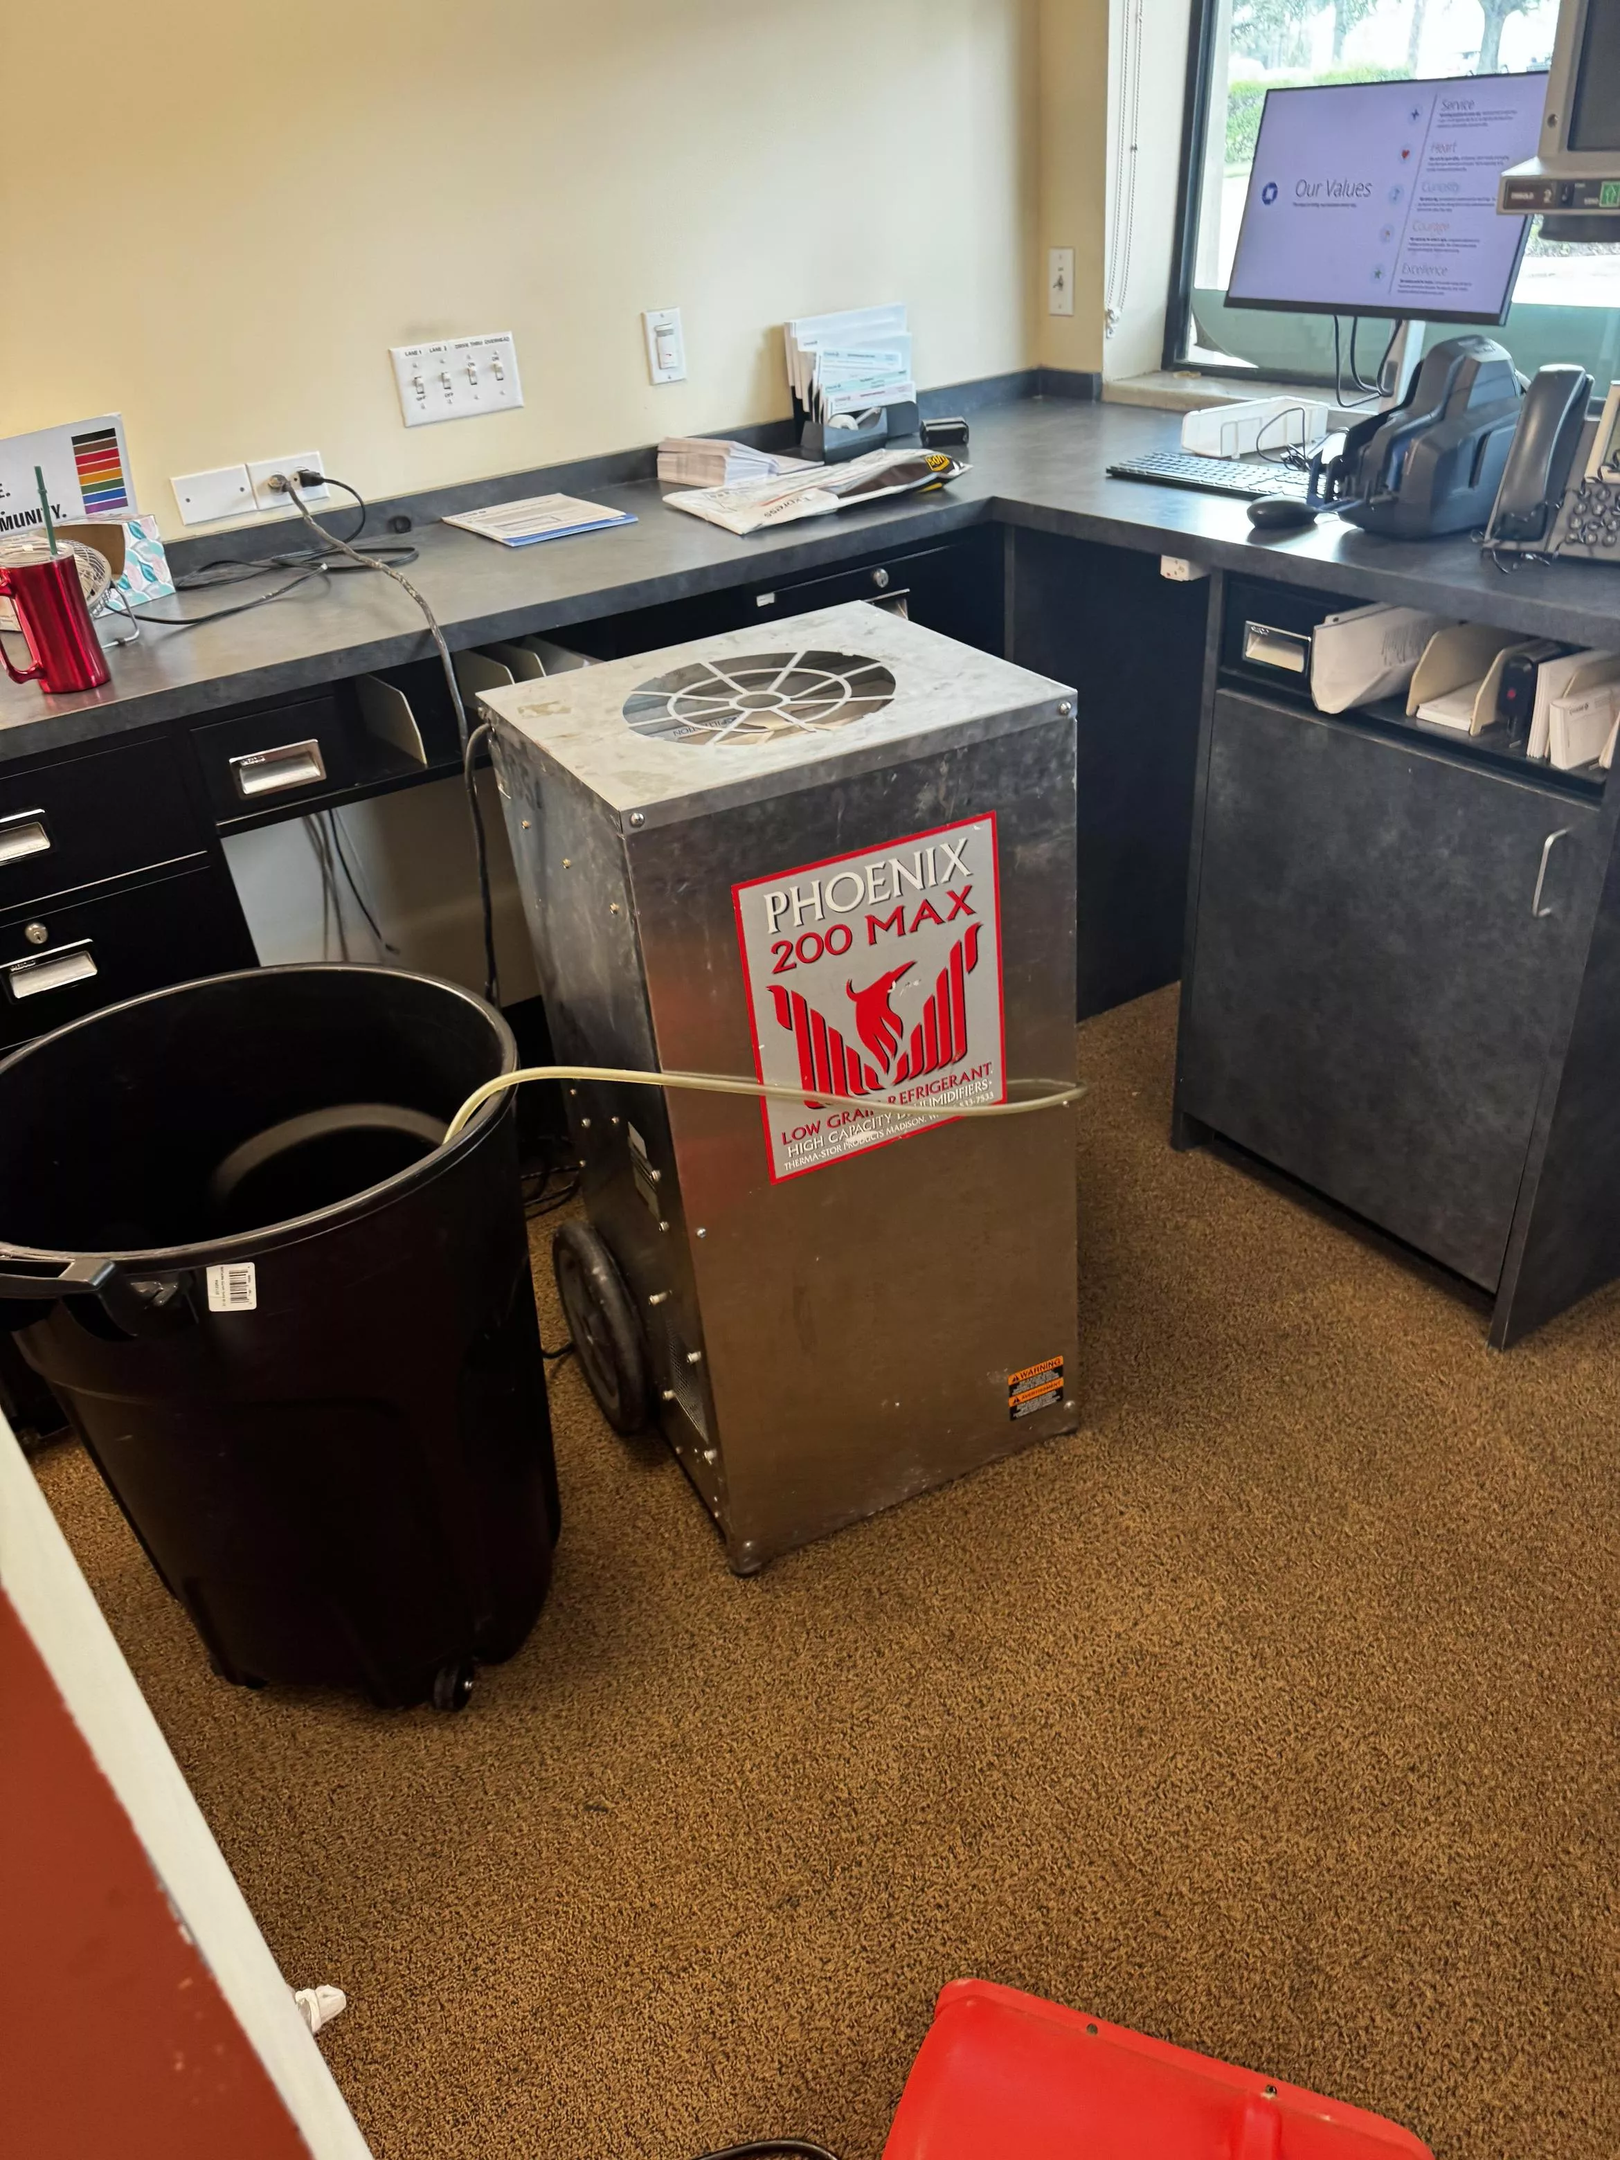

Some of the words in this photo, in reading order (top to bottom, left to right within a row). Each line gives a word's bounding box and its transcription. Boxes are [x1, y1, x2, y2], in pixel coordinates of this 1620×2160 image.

[1295, 178, 1323, 198] Our
[1326, 177, 1373, 198] Values
[0, 503, 67, 532] MUNIY.
[763, 837, 974, 935] PHOENIX
[771, 923, 853, 975] 200
[865, 884, 977, 946] MAX
[781, 1120, 821, 1146] LOW
[787, 1135, 826, 1158] HIGH
[828, 1111, 893, 1144] CAPACITY
[784, 1143, 842, 1171] THERMA-STOR
[1020, 1357, 1061, 1379] WARNING
